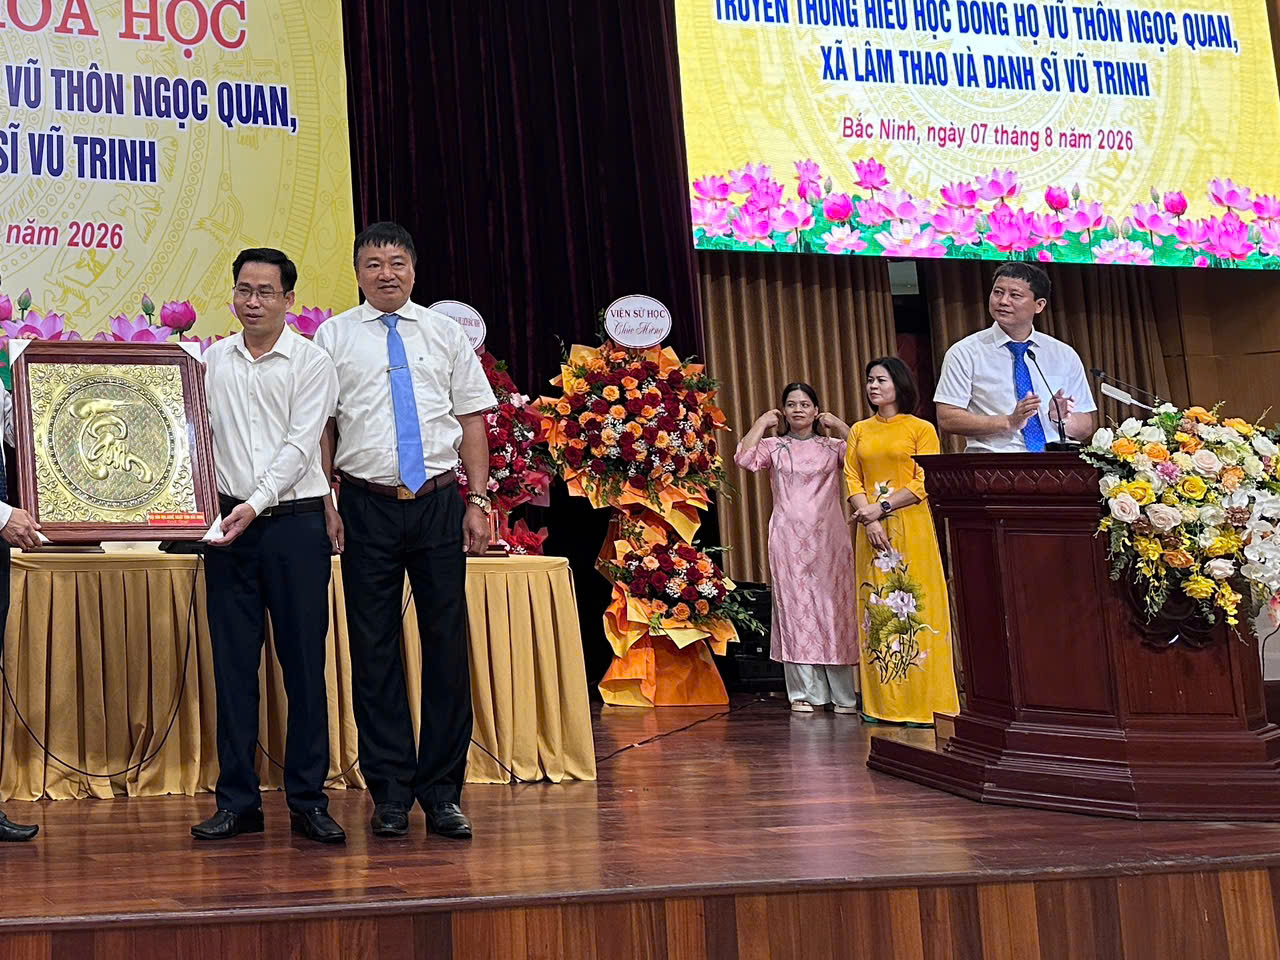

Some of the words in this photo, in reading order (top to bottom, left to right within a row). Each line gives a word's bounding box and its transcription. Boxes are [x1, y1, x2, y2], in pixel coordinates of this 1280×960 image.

[1014, 4, 1040, 47] HỌ
[1044, 0, 1069, 40] VŨ
[1073, 2, 1122, 43] THÔN
[1128, 11, 1178, 53] NGỌC
[1183, 13, 1238, 53] QUAN,
[821, 38, 848, 81] XÃ
[853, 40, 895, 84] LÂM
[900, 51, 949, 86] THAO
[953, 47, 980, 88] VÀ
[983, 54, 1035, 91] DANH
[1041, 51, 1060, 92] SĨ
[1063, 52, 1089, 93] VŨ
[1092, 60, 1150, 97] TRINH
[6, 58, 42, 110] VŨ
[51, 63, 124, 115] THÔN
[134, 75, 208, 129] NGỌC
[217, 81, 297, 133] QUAN,
[28, 126, 64, 177] VŨ
[73, 136, 157, 182] TRINH
[842, 112, 873, 138] Bắc
[880, 118, 921, 143] Ninh,
[926, 121, 966, 147] ngày
[971, 123, 988, 144] 07
[994, 124, 1040, 151] tháng
[1045, 128, 1053, 147] 8
[1058, 126, 1093, 149] năm
[1098, 130, 1134, 151] 2026
[6, 217, 59, 247] năm
[67, 221, 124, 250] 2026
